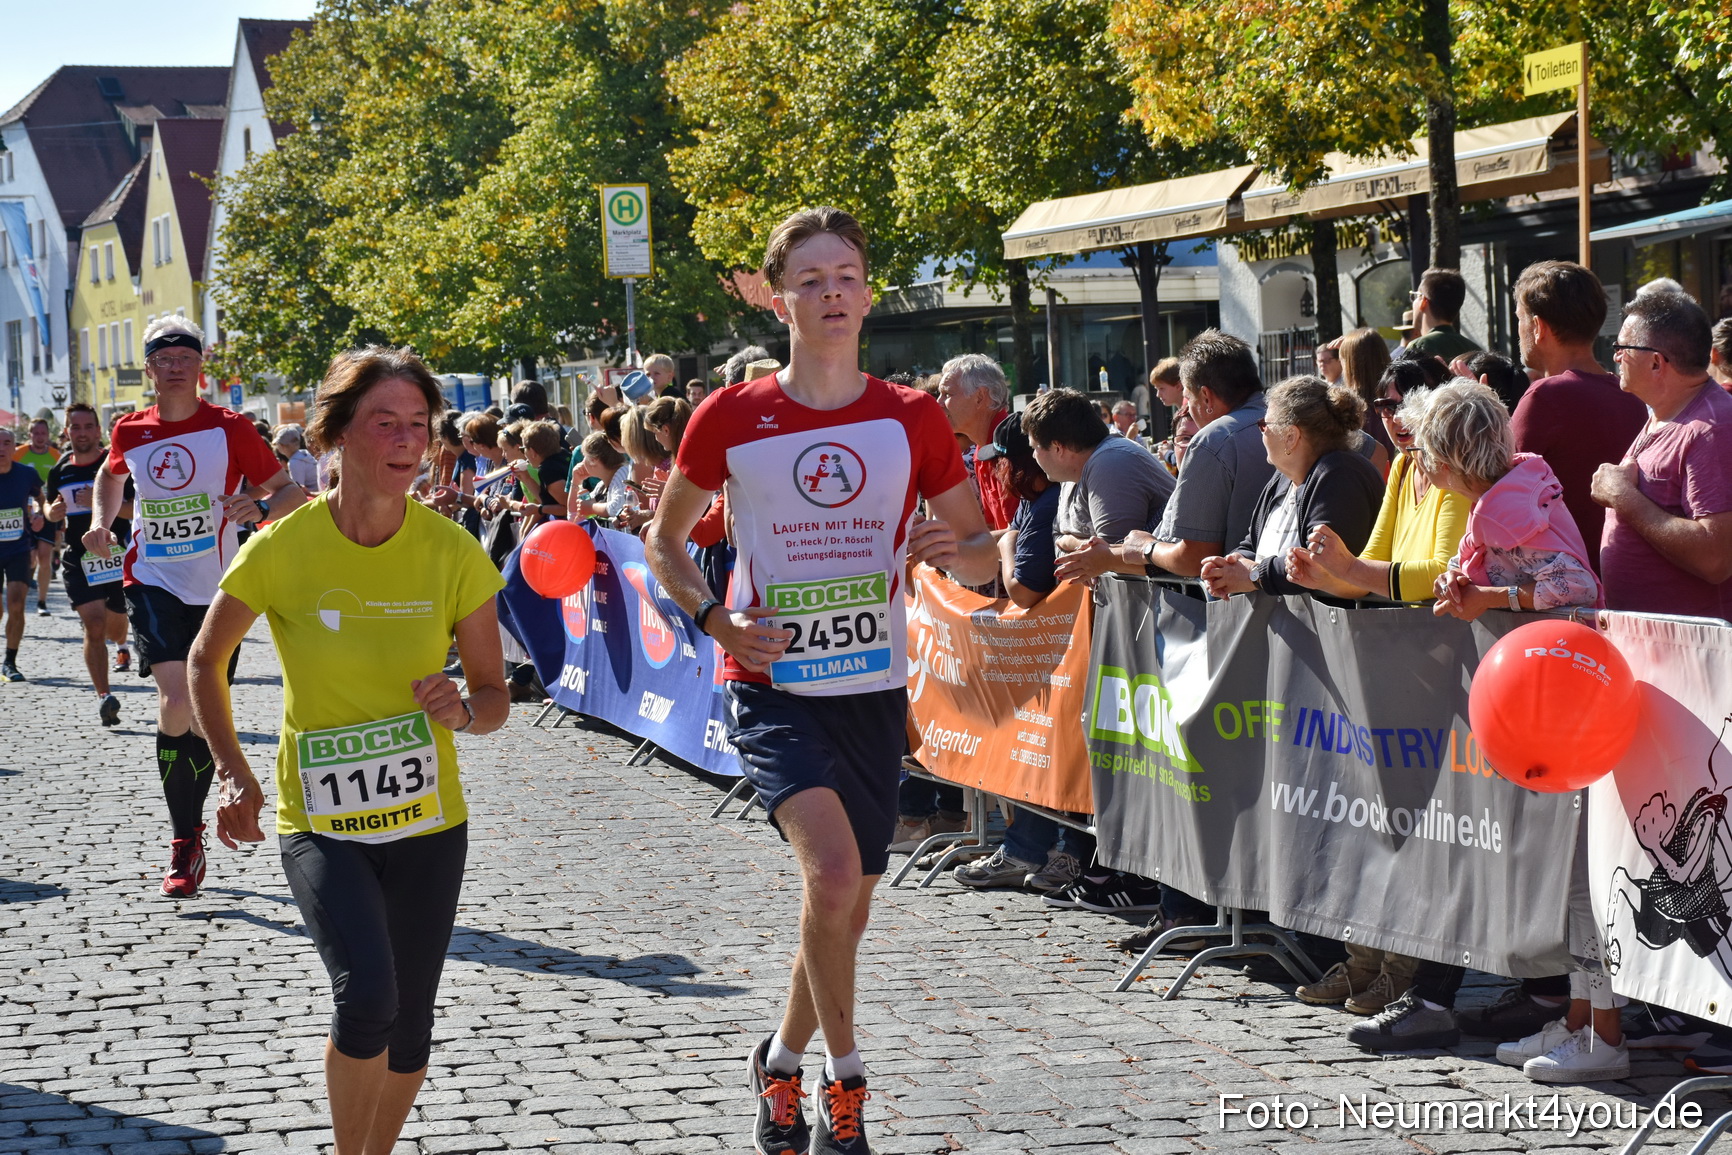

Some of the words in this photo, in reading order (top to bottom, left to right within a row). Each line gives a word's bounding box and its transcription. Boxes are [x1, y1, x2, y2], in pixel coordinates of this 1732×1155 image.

[1535, 58, 1579, 81] Toiletten
[616, 198, 635, 218] H
[147, 498, 203, 515] BOCK
[149, 516, 206, 541] 2452
[166, 543, 194, 556] RUDI
[786, 539, 799, 548] Dr.
[801, 537, 823, 547] Heck
[830, 537, 844, 546] Dr.
[845, 535, 873, 545] Röschl
[87, 555, 122, 573] 2168
[788, 549, 873, 563] Leistungsdiagnostik
[776, 581, 875, 609] BOCK
[782, 611, 878, 654] 2450
[1003, 615, 1038, 629] moderner
[1038, 613, 1074, 627] Partner
[1028, 632, 1046, 647] und
[798, 656, 868, 679] TILMAN
[999, 650, 1034, 668] Projekte
[1034, 652, 1051, 664] was
[1524, 638, 1612, 681] RÖDL
[1025, 669, 1040, 683] und
[1571, 662, 1610, 687] energie
[309, 721, 418, 762] BOCK
[923, 719, 982, 758] Agentur
[1293, 707, 1445, 770] INDUSTRY
[1089, 744, 1147, 776] inspired
[1149, 756, 1157, 785] by
[319, 757, 425, 807] 1143
[330, 803, 423, 832] BRIGITTE
